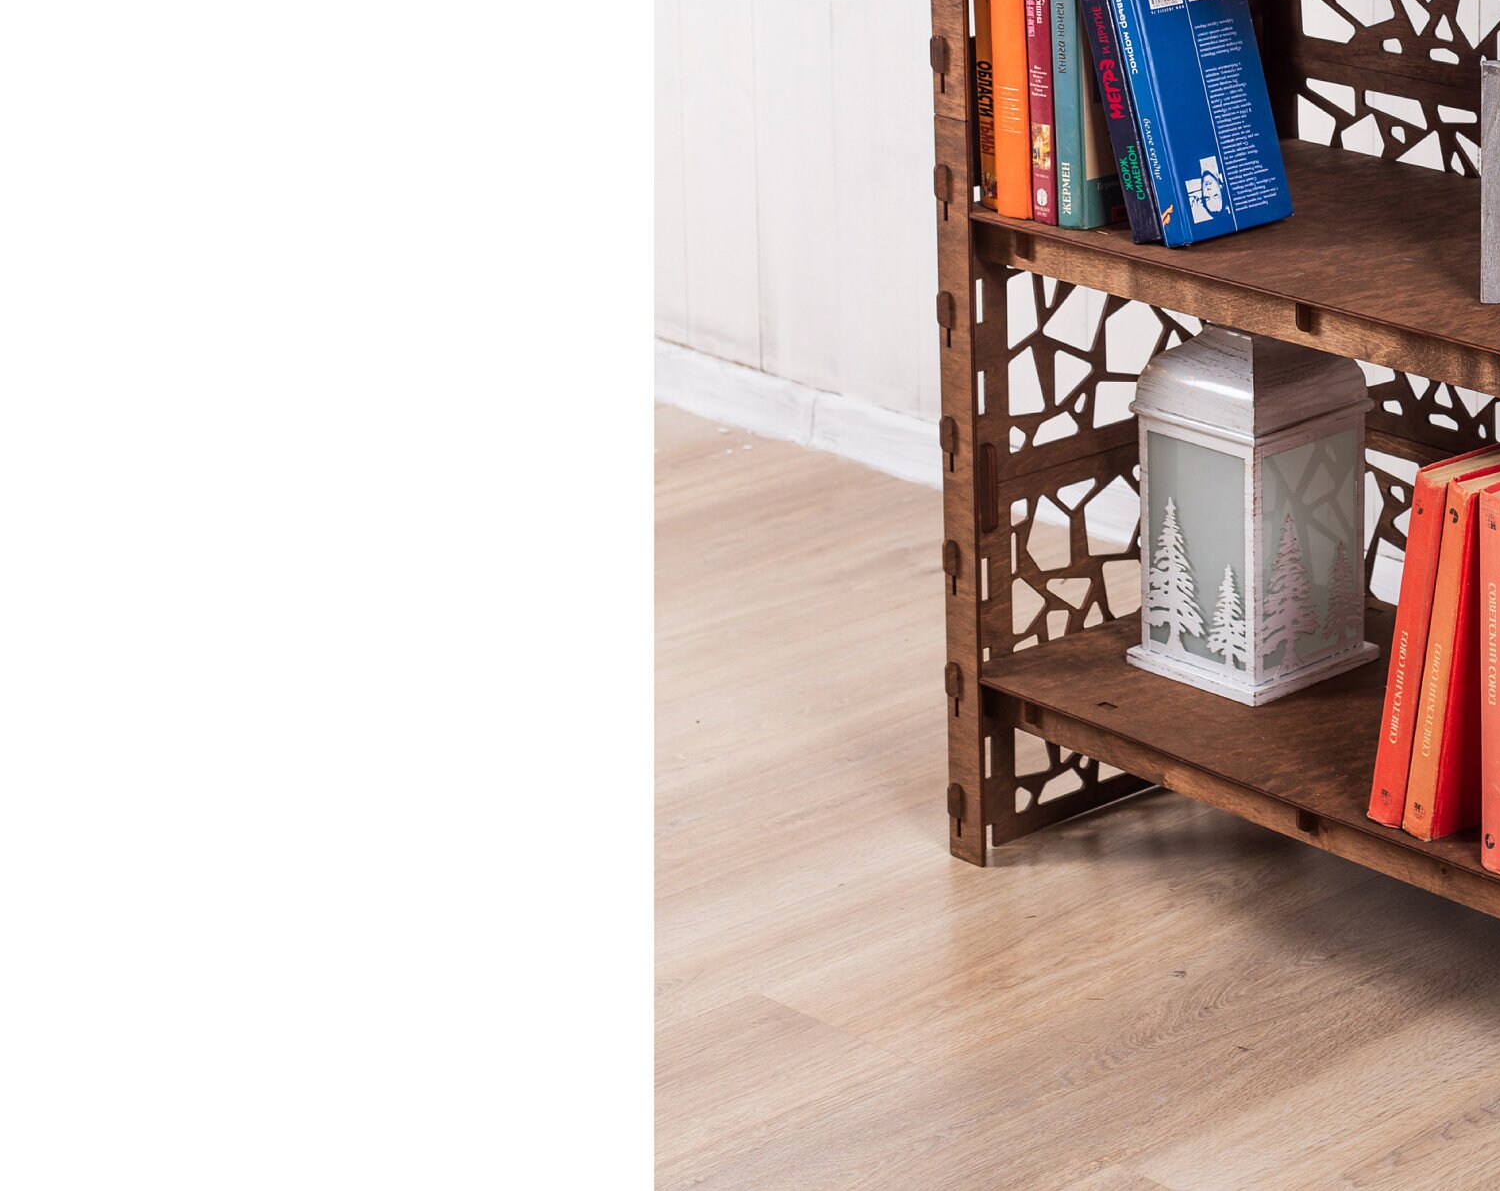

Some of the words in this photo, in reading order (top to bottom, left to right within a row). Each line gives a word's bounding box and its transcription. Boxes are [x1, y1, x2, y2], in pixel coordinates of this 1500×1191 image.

[1055, 2, 1065, 37] ночей
[1092, 6, 1110, 44] ДРУГИЕ
[1058, 40, 1067, 74] Книга
[1123, 31, 1139, 75] мариас
[976, 60, 994, 117] ОБЛАСТИ
[1100, 58, 1126, 120] МЕГРЭ
[980, 120, 995, 156] ТЬМЫ
[1143, 118, 1154, 146] белое
[1149, 147, 1162, 181] сердце
[1061, 162, 1072, 215] ЖЕРМЕН
[1120, 156, 1134, 191] ЖОРЖ
[1126, 145, 1146, 200] СИМЕНОН
[1488, 582, 1497, 663] СОВЕТСКИЙ
[1388, 669, 1405, 744] СОВЕТСКИЙ
[1398, 630, 1409, 668] СОЮЗ
[1421, 681, 1438, 758] СОВЕТСКИЙ
[1431, 642, 1442, 680] СОЮЗ
[1487, 666, 1497, 706] СОЮЗ
